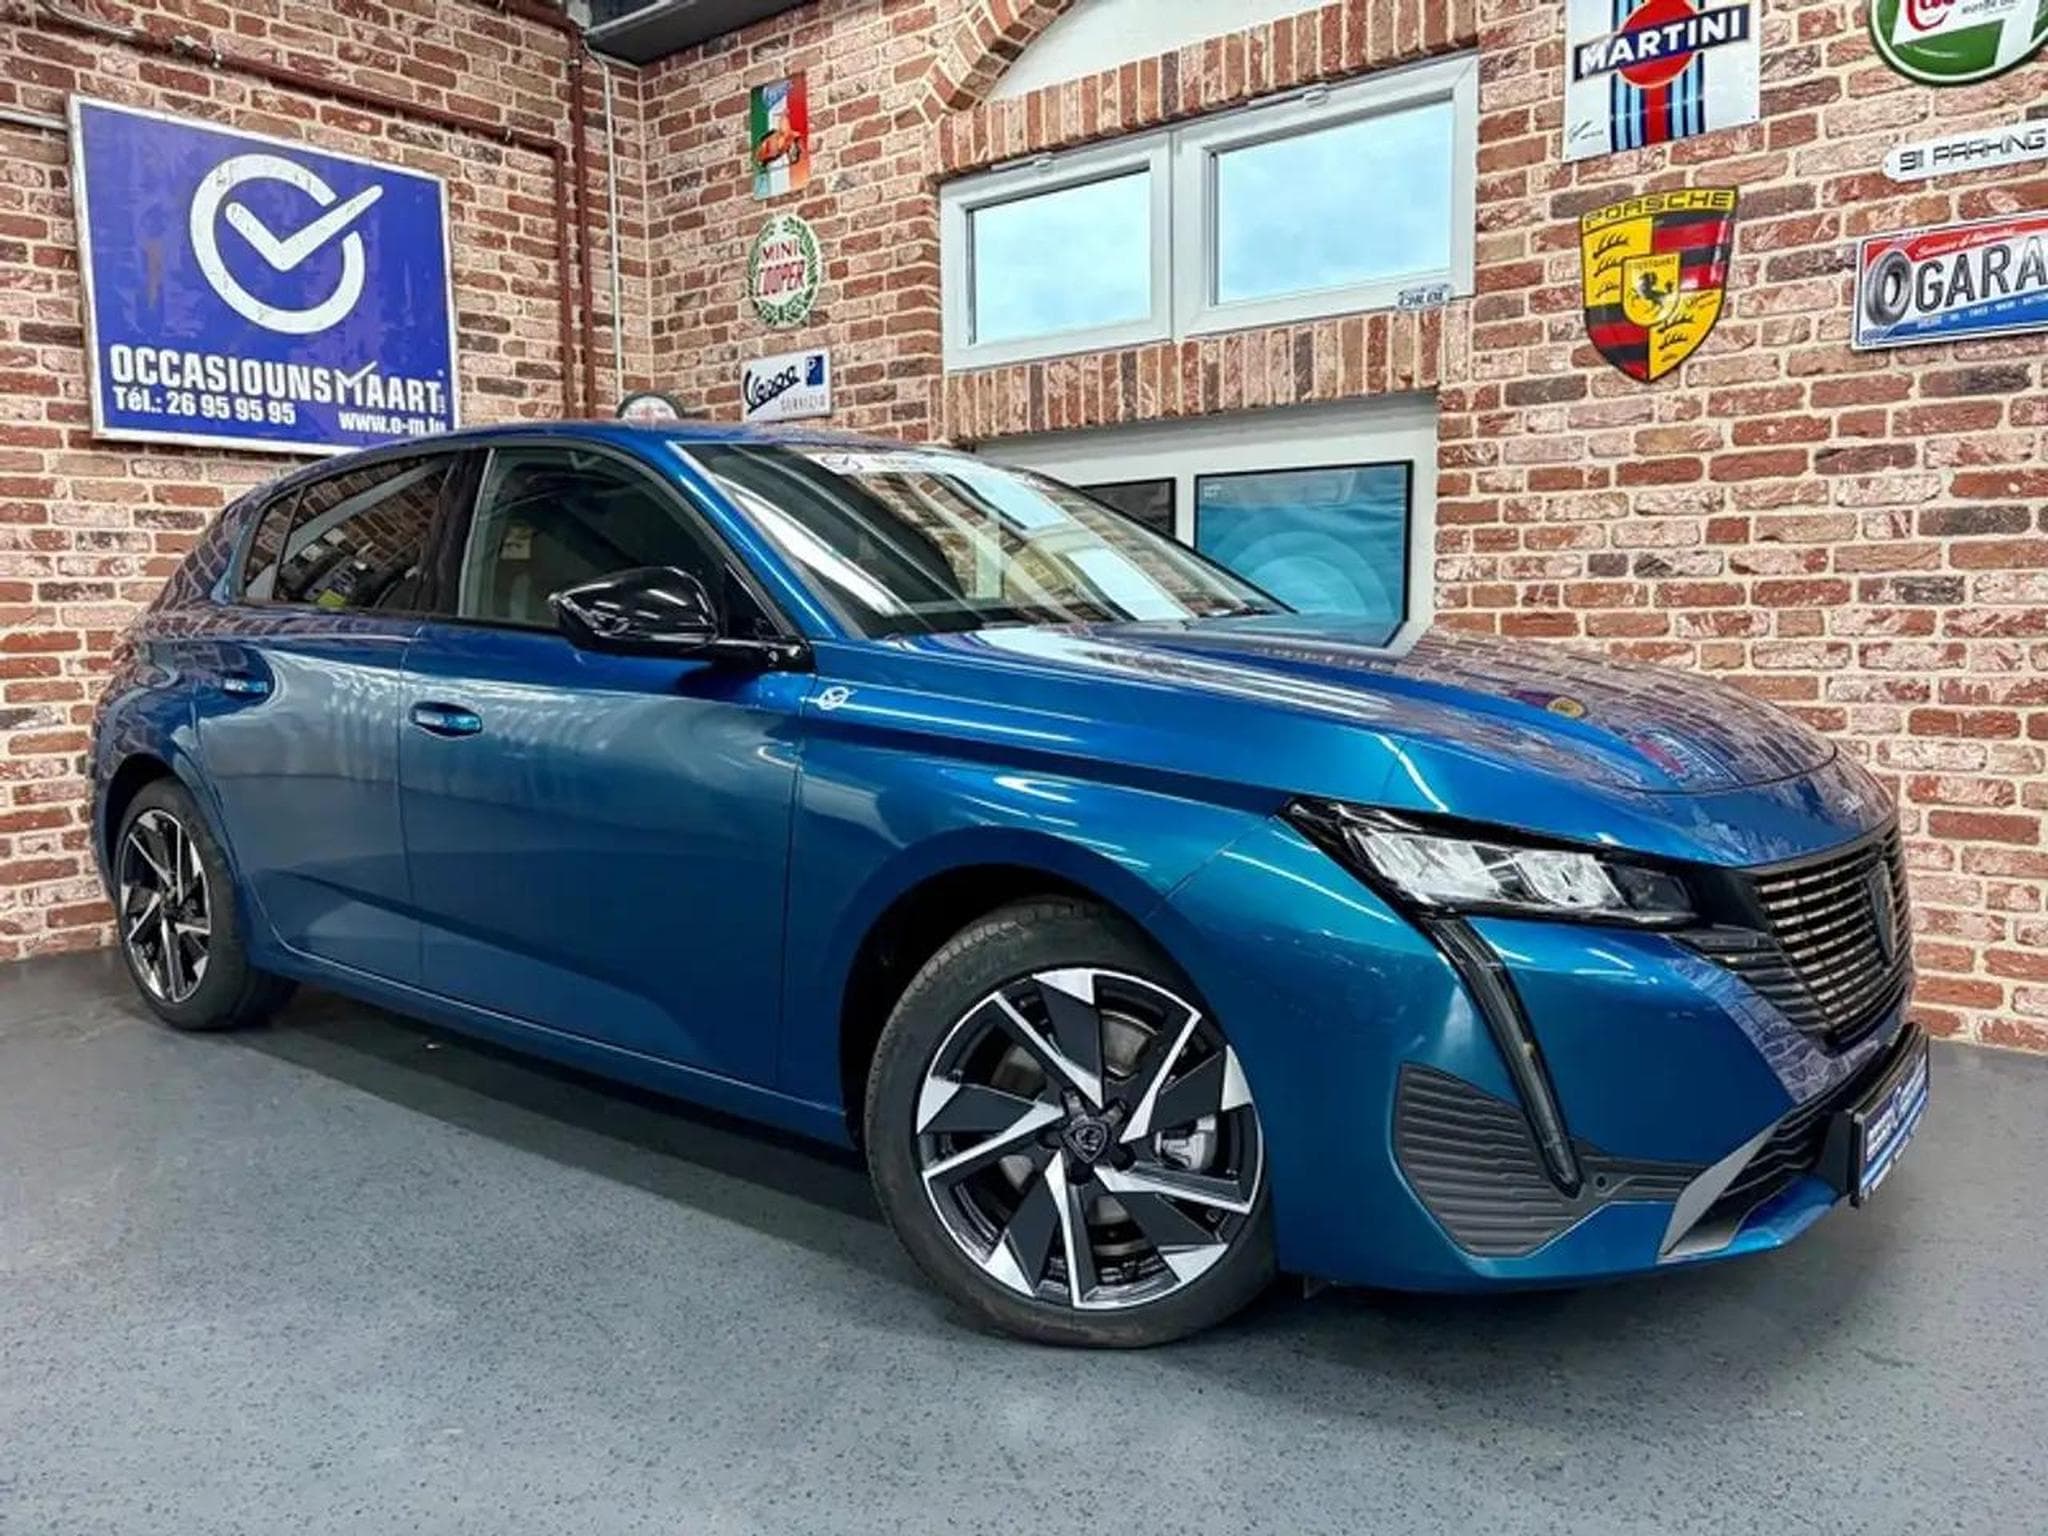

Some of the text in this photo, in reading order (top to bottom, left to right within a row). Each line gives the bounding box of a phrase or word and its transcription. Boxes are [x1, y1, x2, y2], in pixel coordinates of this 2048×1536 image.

[1579, 10, 1740, 74] MARTINI
[1933, 128, 2047, 167] PARKING
[1585, 191, 1731, 229] PORSCHE
[762, 240, 798, 260] MINI
[756, 261, 805, 296] COOPER
[110, 344, 441, 413] OCCASIOUNSMAART
[743, 369, 801, 414] Vespa
[112, 386, 296, 425] Tél.: 26 95 95 95
